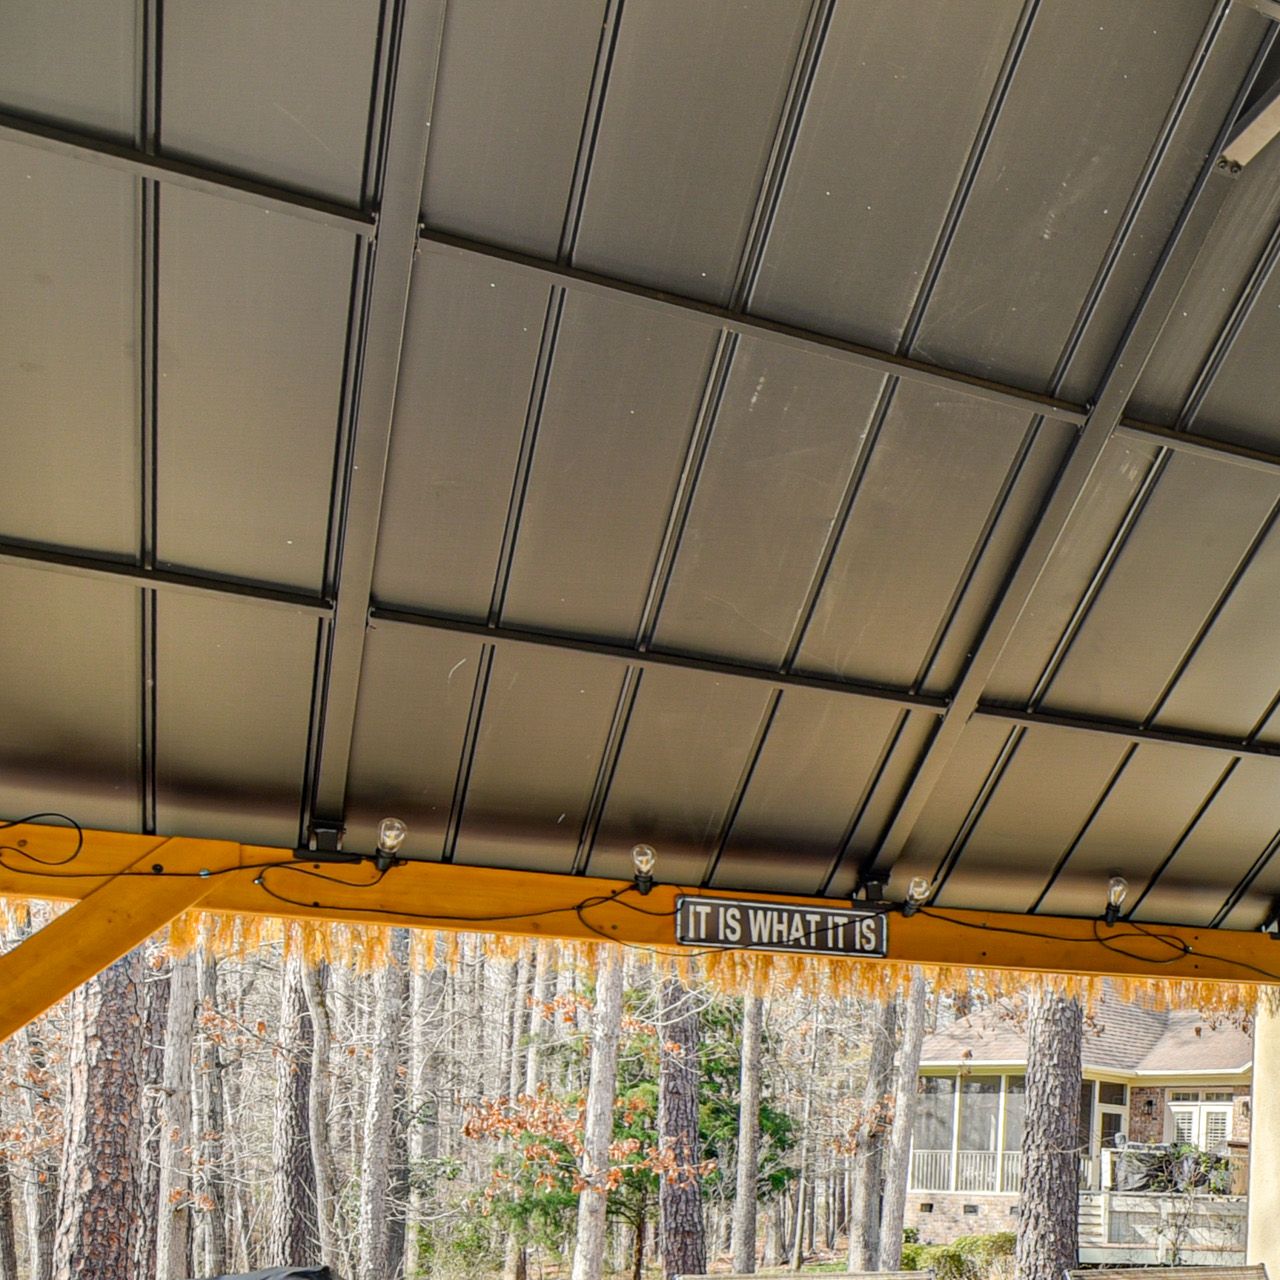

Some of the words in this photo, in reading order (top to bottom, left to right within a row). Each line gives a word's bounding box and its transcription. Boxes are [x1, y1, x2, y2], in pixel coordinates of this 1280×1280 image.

[688, 904, 712, 939] IT
[718, 906, 742, 942] IS
[748, 909, 821, 947] WHAT
[826, 914, 849, 949] IT
[854, 918, 877, 951] IS
